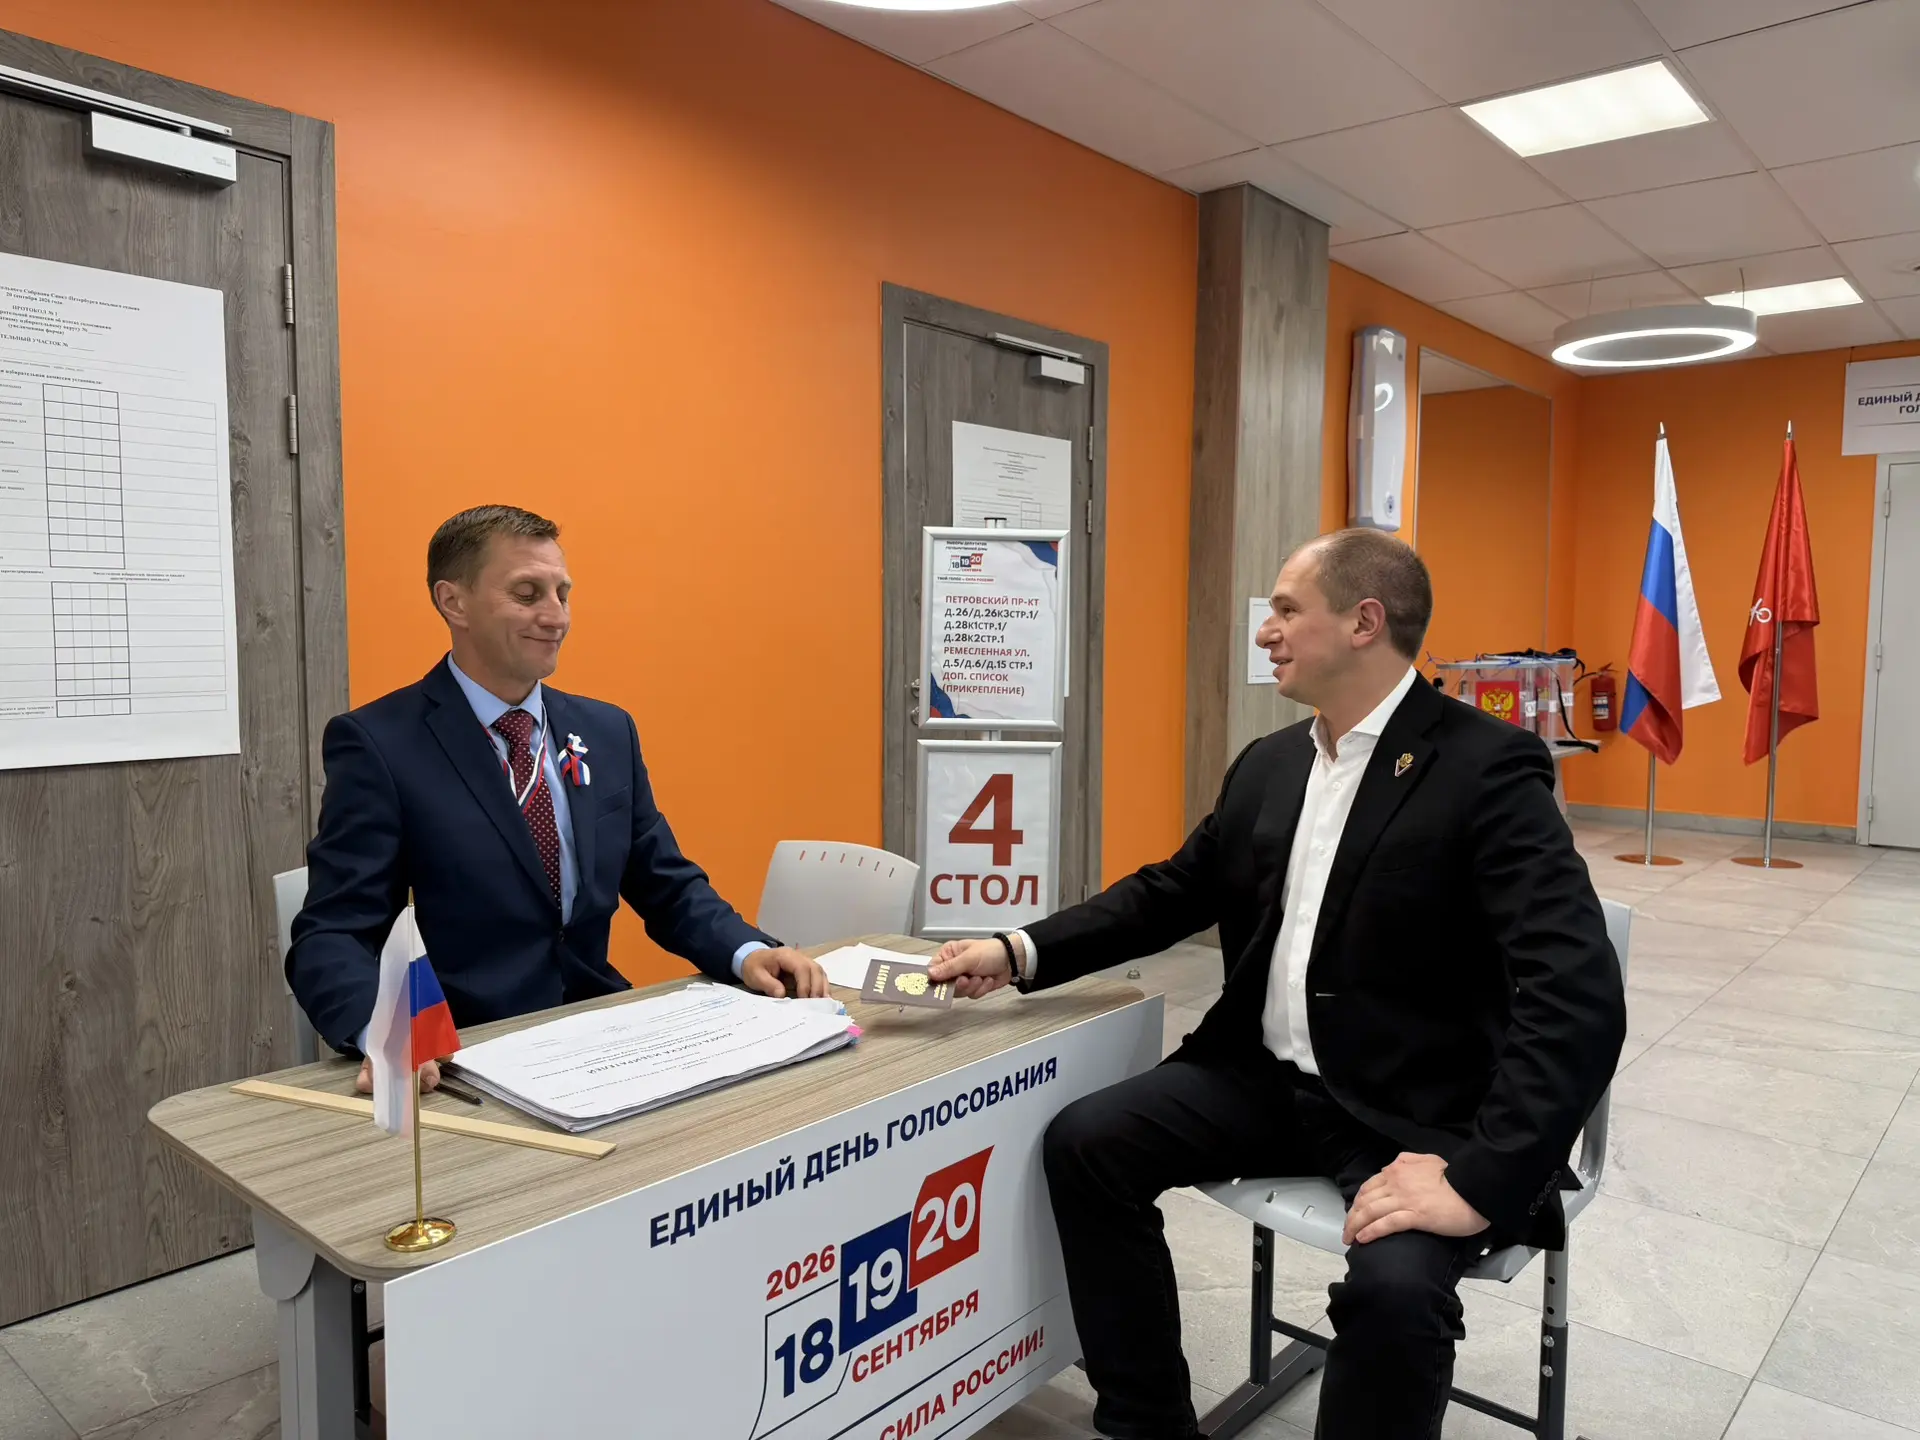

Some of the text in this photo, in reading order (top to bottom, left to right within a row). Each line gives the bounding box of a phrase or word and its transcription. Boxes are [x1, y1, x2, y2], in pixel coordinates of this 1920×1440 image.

[12, 305, 47, 314] ПРОТОКОЛ
[32, 338, 62, 347] УЧАСТОК
[1858, 390, 1913, 406] ЕДИНЫЙ
[951, 561, 960, 569] 18
[945, 595, 1040, 606] ПЕТРОВСКИЙ ПР-КТ
[943, 658, 1033, 670] Д.5/Д.6/Д.15 СТР.1
[944, 646, 1030, 657] РЕМЕСЛЕННАЯ УЛ.
[942, 672, 1008, 682] ДОП. СПИСОК
[942, 683, 1025, 697] (ПРИКРЕПЛЕНИЕ)
[949, 774, 1023, 866] 4
[930, 873, 1038, 906] СТОЛ
[873, 964, 890, 994] ПАСПОРТ
[650, 1056, 1057, 1248] ЕДИНЫЙ ДЕНЬ ГОЛОСОВАНИЯ
[916, 1181, 976, 1262] 20
[766, 1244, 836, 1300] 2026
[848, 1248, 902, 1324] 19
[852, 1289, 979, 1383] СЕНТЯБРЯ
[774, 1318, 834, 1398] 18
[880, 1326, 1044, 1440] СИЛА РОССИИ!
